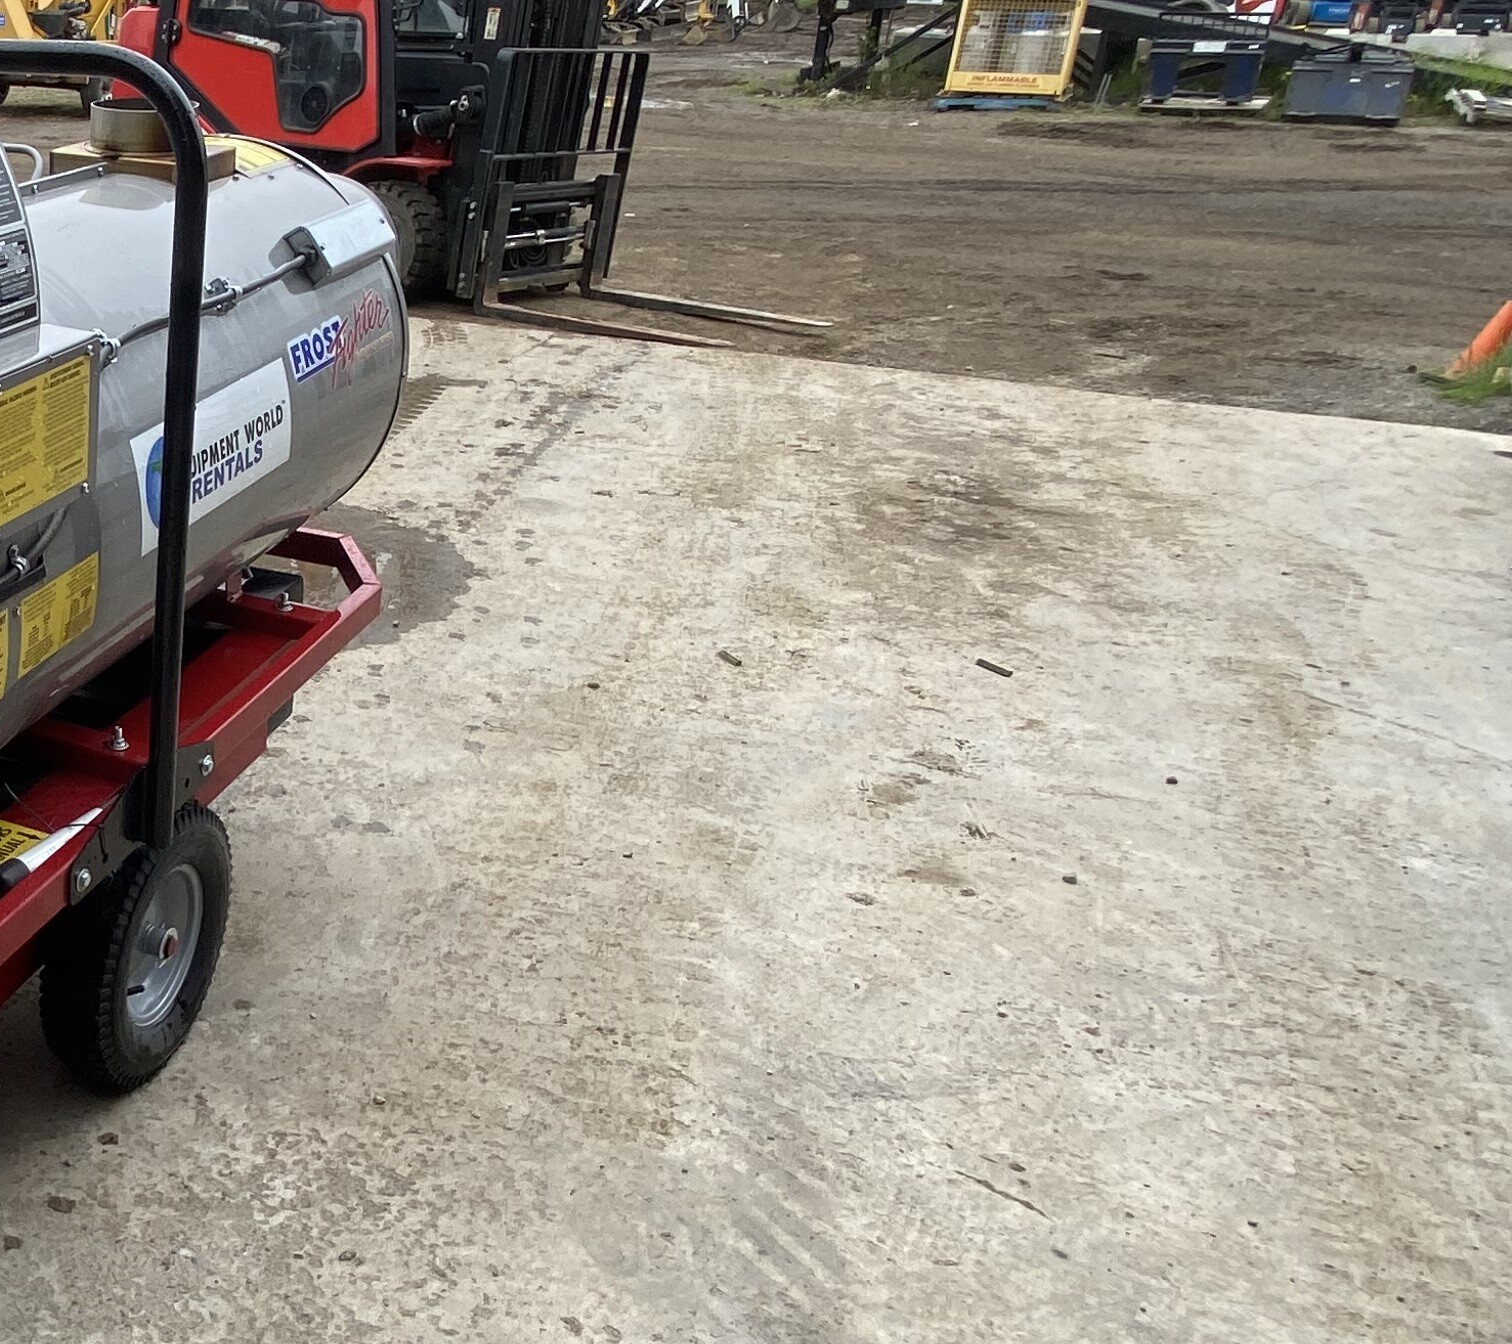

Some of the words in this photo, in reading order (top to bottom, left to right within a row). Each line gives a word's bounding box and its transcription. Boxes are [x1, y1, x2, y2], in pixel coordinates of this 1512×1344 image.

[971, 75, 1039, 84] INFLAMMABLE
[289, 320, 342, 375] FROST
[329, 288, 390, 390] Fighter
[243, 403, 284, 445] WORLD
[191, 439, 264, 504] RENTALS
